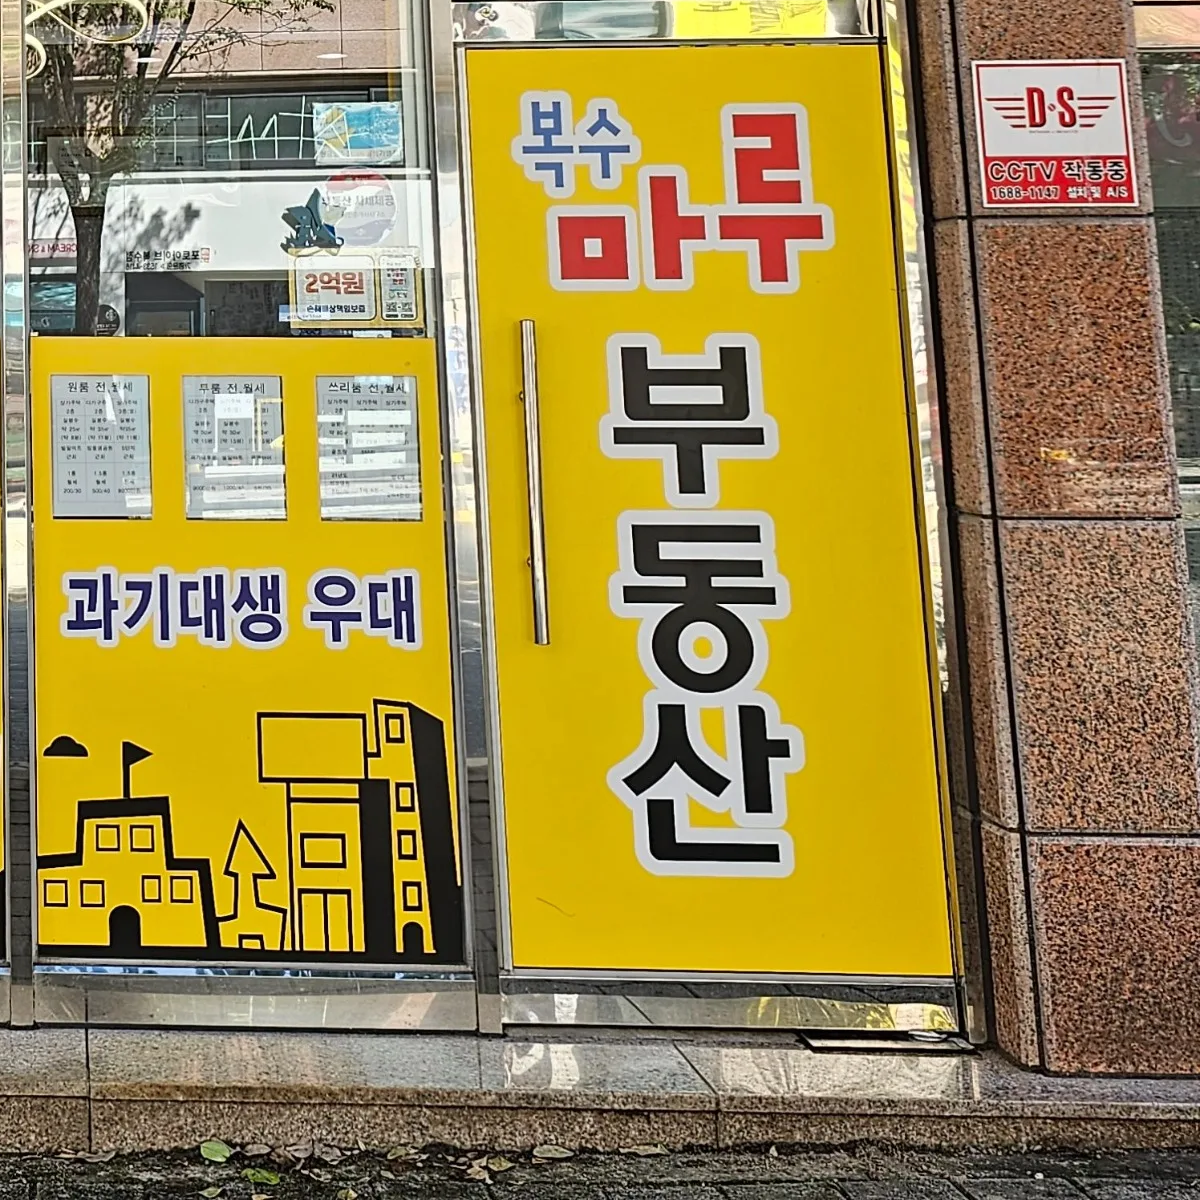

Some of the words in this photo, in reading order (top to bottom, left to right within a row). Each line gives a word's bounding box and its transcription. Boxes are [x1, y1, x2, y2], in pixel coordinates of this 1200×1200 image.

[521, 100, 632, 189] 복수
[988, 161, 1055, 182] CCTV
[1062, 160, 1127, 182] 작동중
[556, 112, 824, 284] 마루
[304, 271, 366, 295] 2억원
[68, 382, 89, 393] 원룸
[328, 382, 362, 393] 쓰리룸
[66, 573, 284, 642] 과기대생
[309, 574, 417, 644] 우대
[612, 346, 792, 864] 부동산
